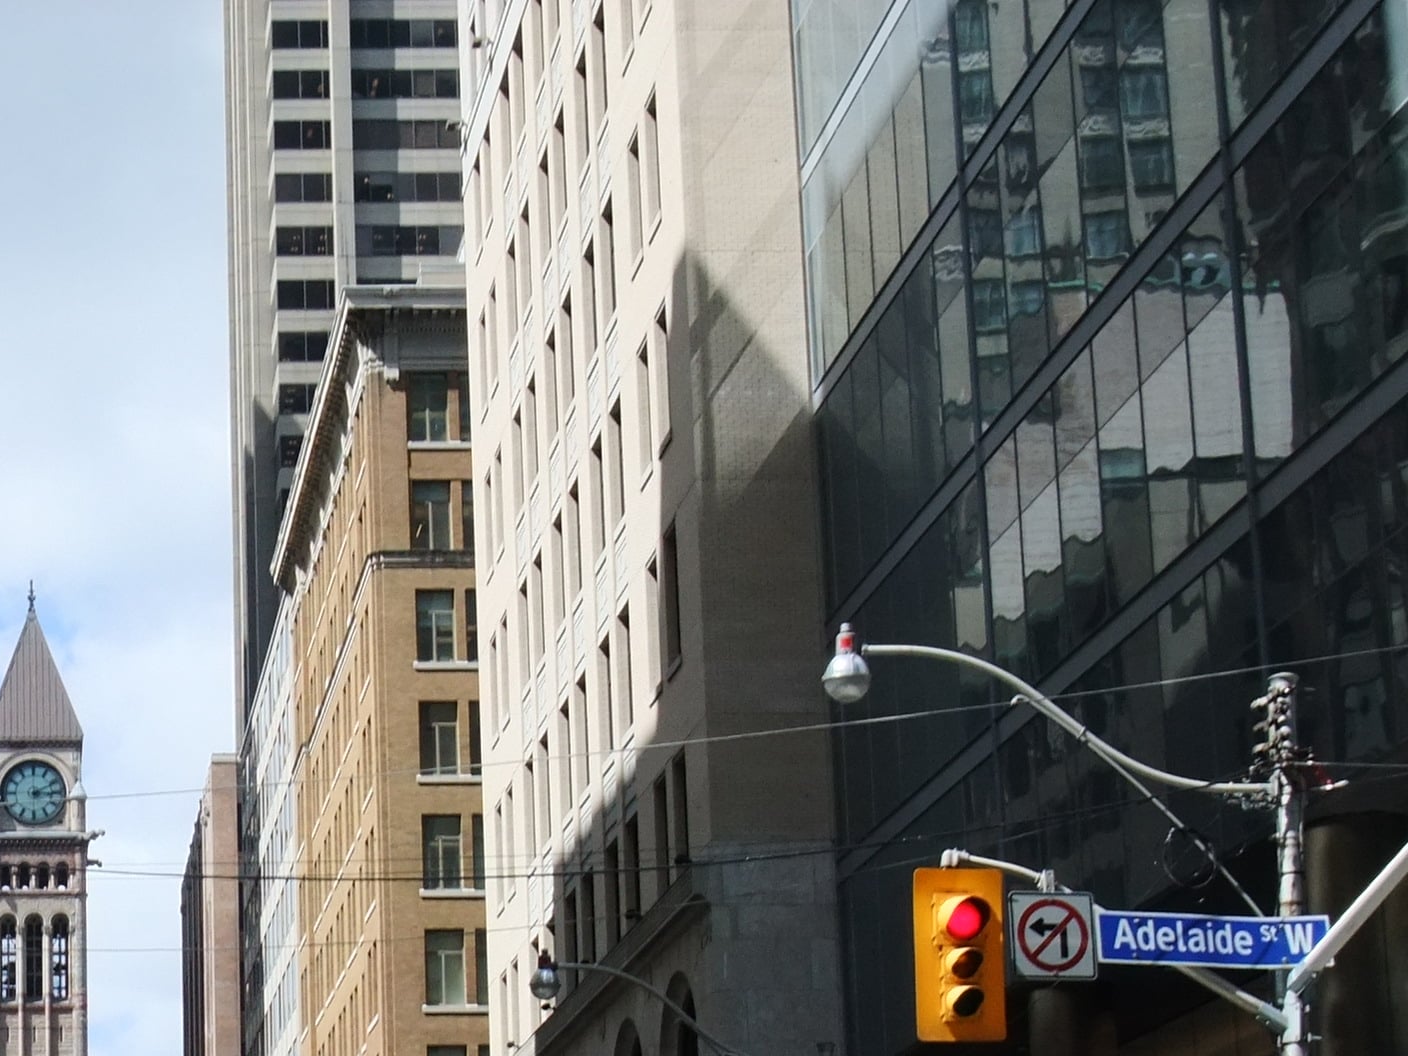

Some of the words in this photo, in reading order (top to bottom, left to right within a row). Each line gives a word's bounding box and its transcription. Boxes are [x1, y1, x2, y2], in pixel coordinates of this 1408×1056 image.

[1113, 917, 1254, 956] Adelaide
[1259, 924, 1278, 942] St
[1285, 922, 1314, 955] W
